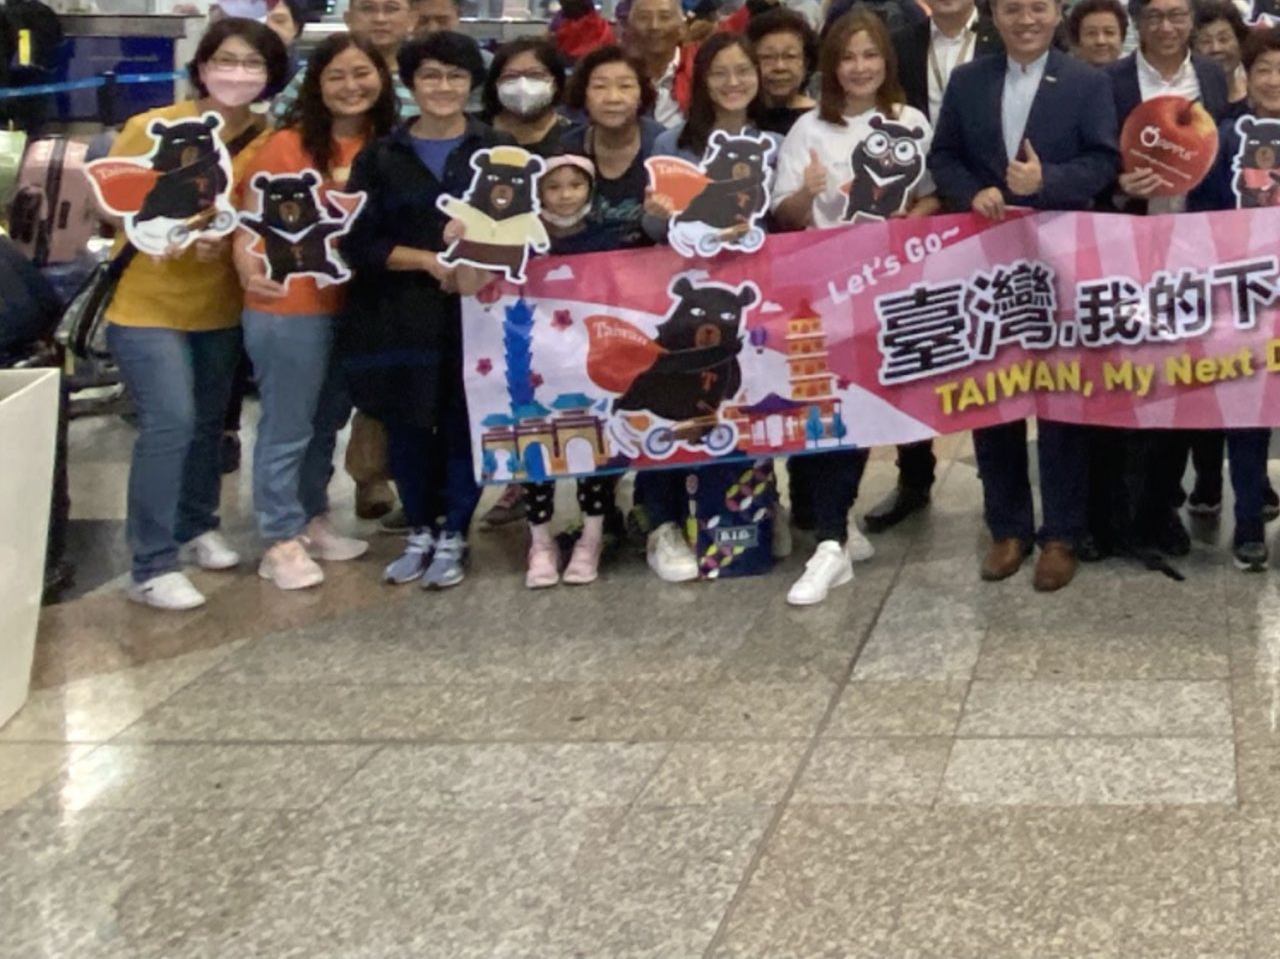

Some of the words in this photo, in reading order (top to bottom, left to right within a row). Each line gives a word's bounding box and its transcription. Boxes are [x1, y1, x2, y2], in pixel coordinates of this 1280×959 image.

[827, 256, 901, 305] Let's
[935, 358, 1094, 416] TAIWAN,
[1103, 358, 1155, 397] My
[1165, 345, 1255, 387] Next
